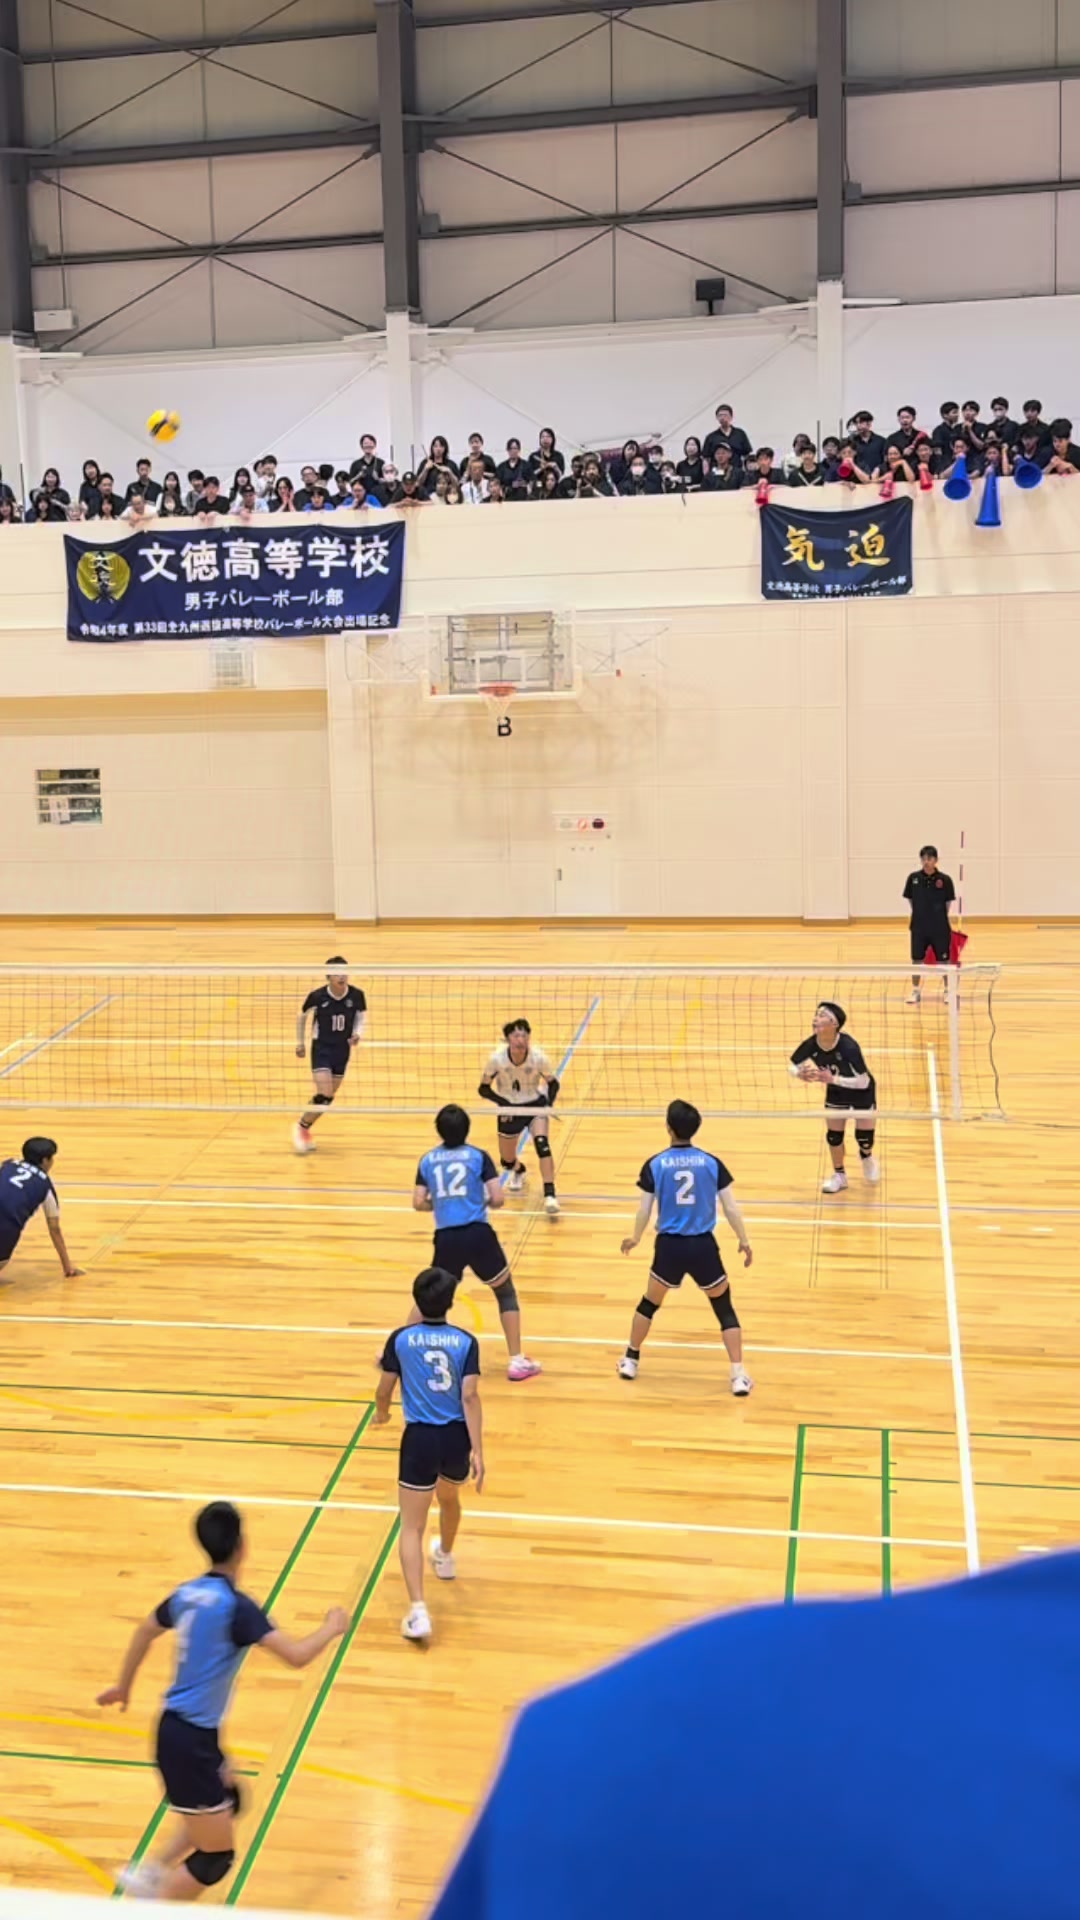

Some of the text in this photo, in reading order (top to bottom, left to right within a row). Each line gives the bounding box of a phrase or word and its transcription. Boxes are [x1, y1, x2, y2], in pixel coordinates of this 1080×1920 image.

[782, 523, 891, 571] 気迫
[138, 536, 390, 583] 文徳高等学校
[185, 588, 344, 611] 男子バレーボール部
[80, 622, 129, 636] 令和4年度
[497, 716, 512, 736] B
[331, 1014, 345, 1032] 10
[661, 1155, 705, 1168] KAISHIN
[9, 1168, 33, 1189] 2
[433, 1162, 468, 1198] 12
[674, 1170, 696, 1205] 2
[407, 1333, 459, 1348] KAISHIN
[423, 1350, 452, 1392] 3
